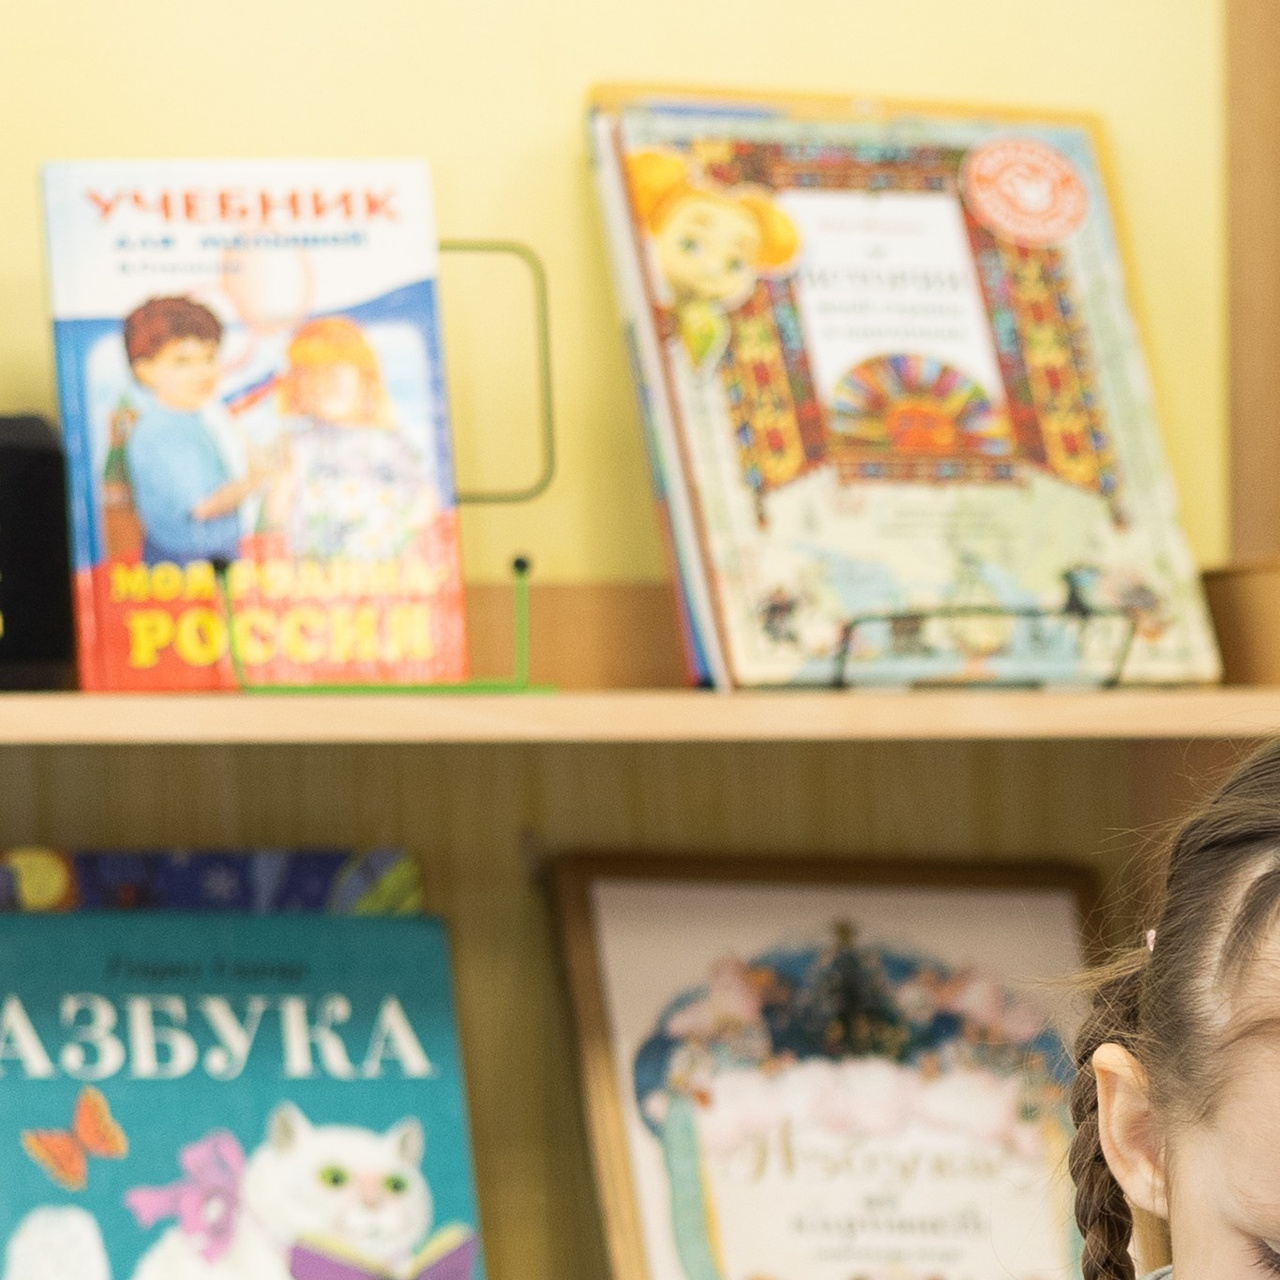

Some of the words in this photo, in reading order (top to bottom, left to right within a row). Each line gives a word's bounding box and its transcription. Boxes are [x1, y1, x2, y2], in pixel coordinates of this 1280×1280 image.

[85, 186, 400, 223] УЧЕБНИК
[125, 605, 436, 668] РОССИЯ
[0, 995, 440, 1080] АЗБУКА
